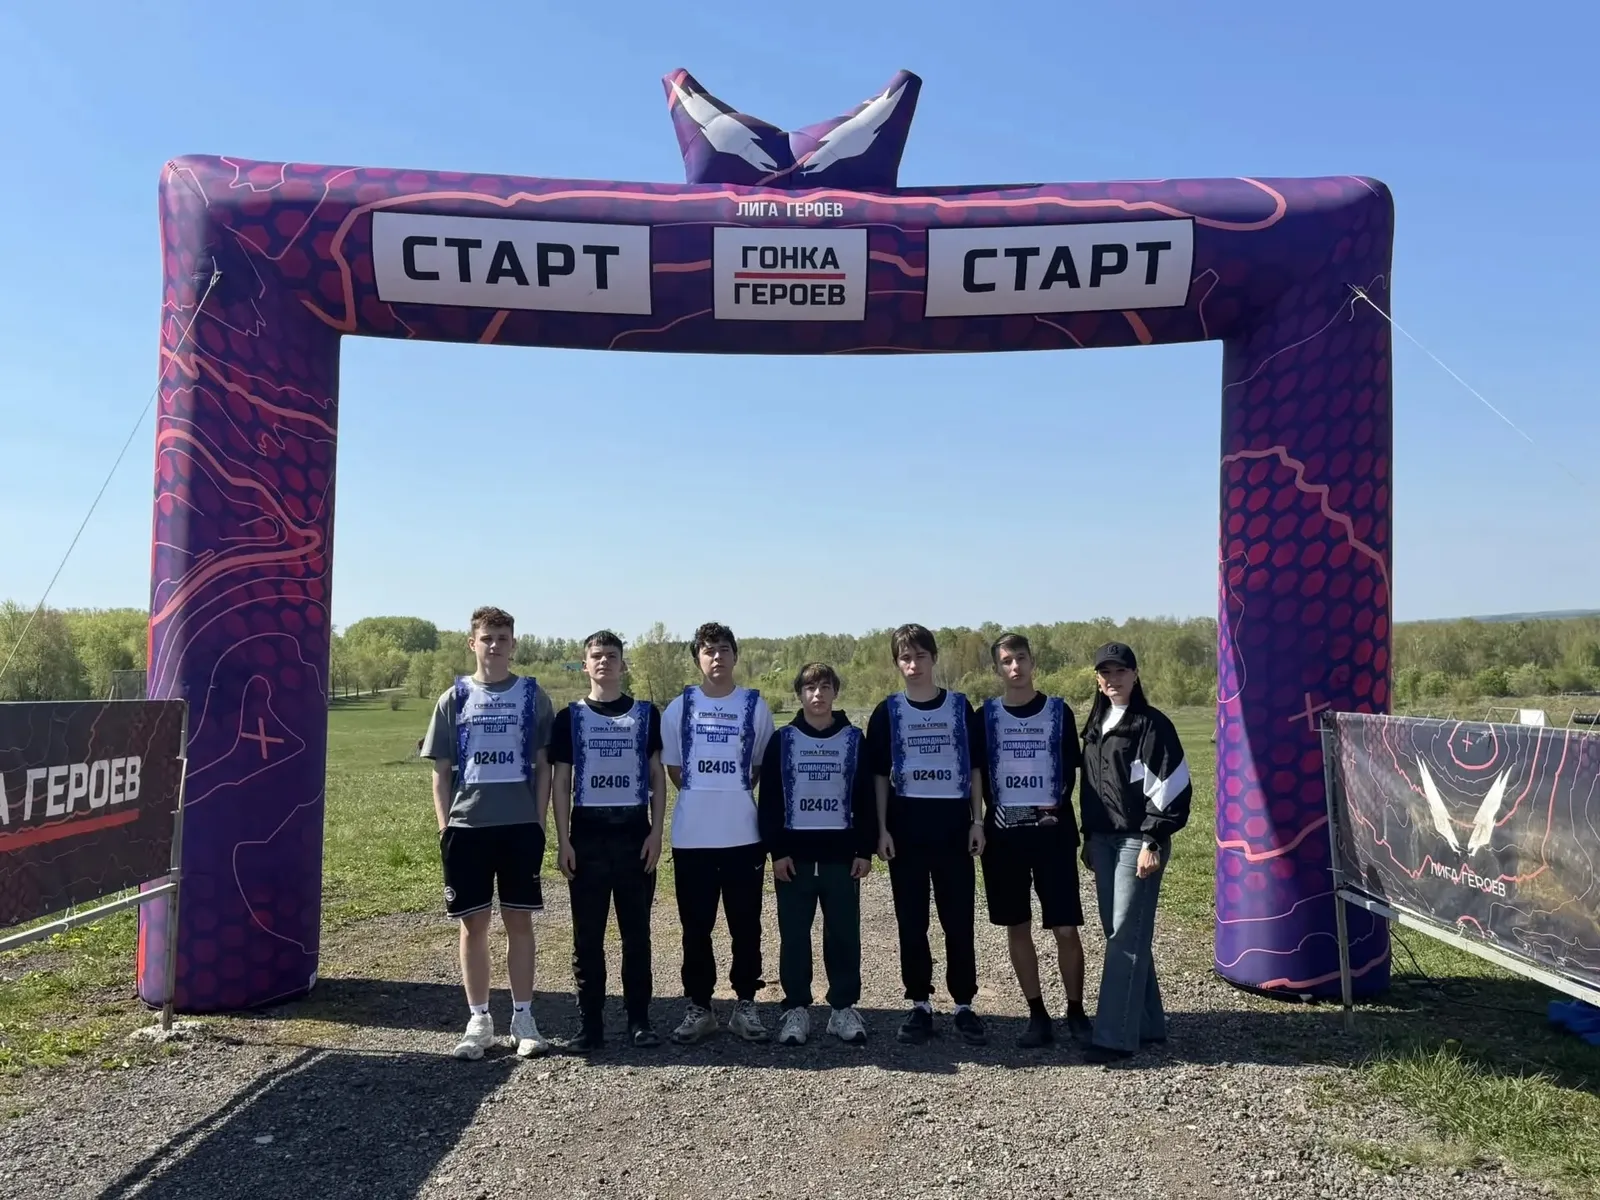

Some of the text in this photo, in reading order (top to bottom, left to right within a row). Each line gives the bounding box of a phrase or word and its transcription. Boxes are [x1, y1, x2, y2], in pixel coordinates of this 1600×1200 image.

[736, 202, 844, 217] ЛИГА ГЕРОЕВ
[402, 235, 620, 290] СТАРТ
[742, 246, 840, 269] ГОНКА
[962, 241, 1172, 293] СТАРТ
[734, 283, 846, 306] ГЕРОЕВ
[485, 724, 506, 732] СТАРТ
[708, 734, 727, 742] СТАРТ
[601, 749, 621, 757] СТАРТ
[920, 745, 940, 753] СТАРТ
[474, 751, 514, 764] 02404
[698, 760, 736, 773] 02405
[810, 772, 829, 780] СТАРТ
[913, 769, 951, 780] 02403
[23, 755, 142, 821] ГЕРОЕВ
[591, 775, 630, 788] 02406
[1006, 776, 1043, 788] 02401
[800, 798, 838, 811] 02402
[1430, 862, 1506, 897] ЛИГА ГЕРОЕВ
